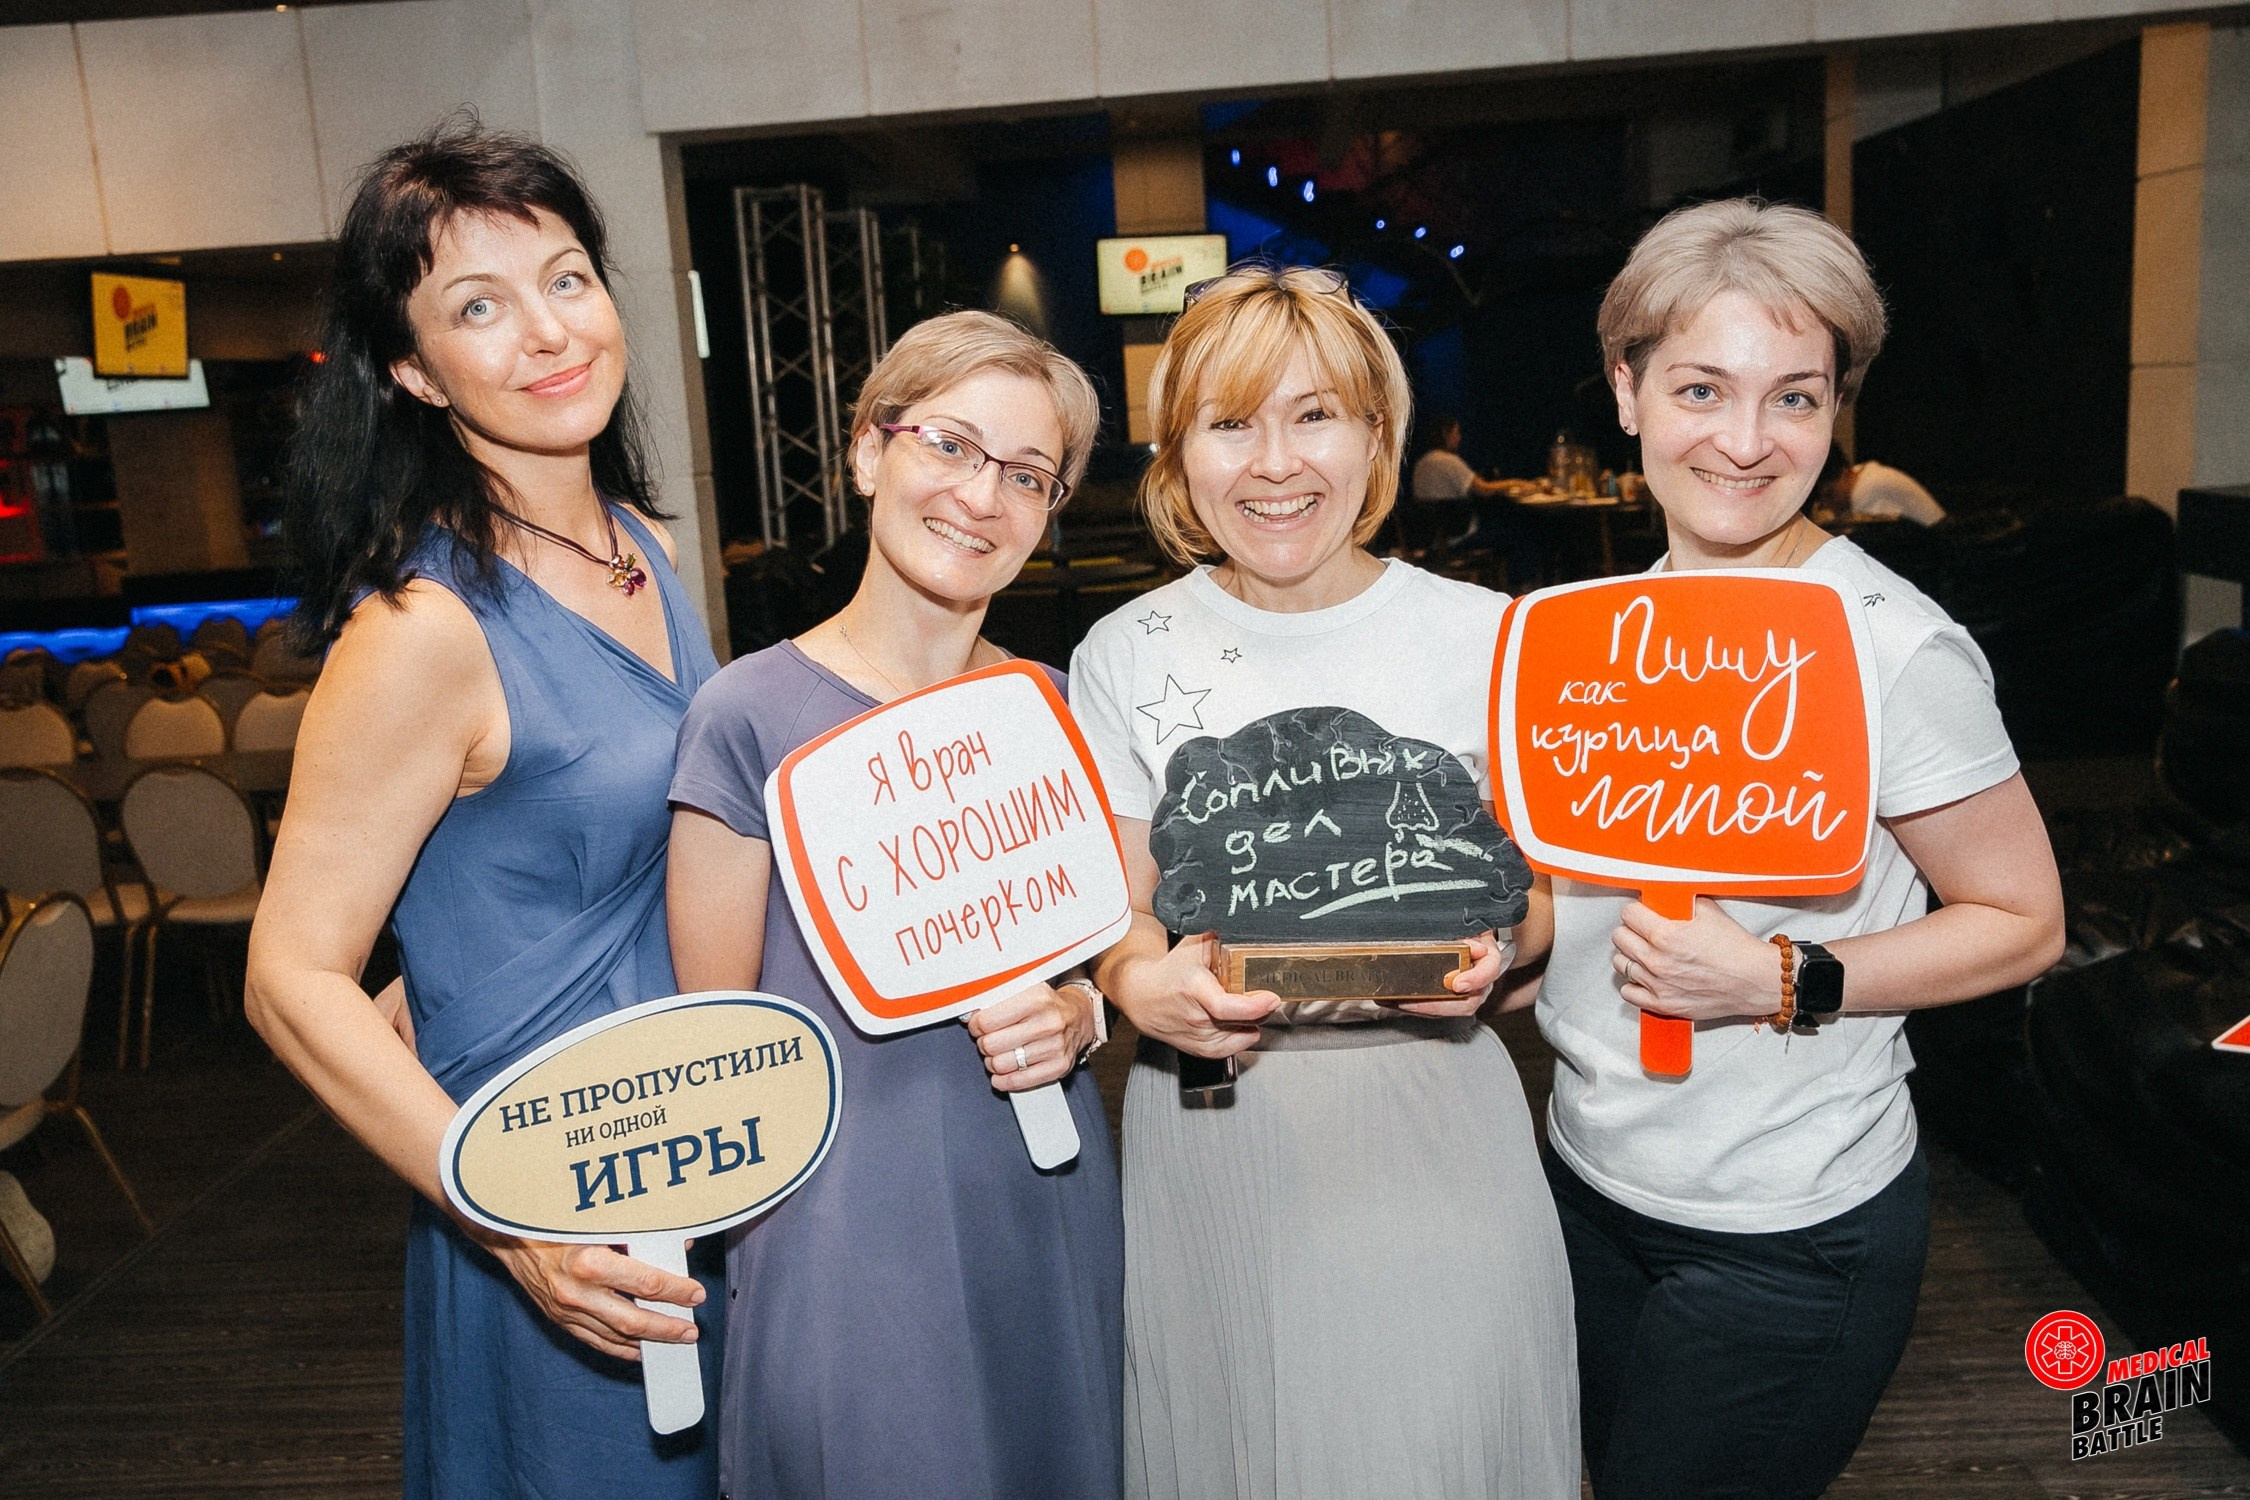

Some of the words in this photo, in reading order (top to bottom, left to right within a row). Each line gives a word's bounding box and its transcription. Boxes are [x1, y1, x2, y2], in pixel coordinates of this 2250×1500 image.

[1558, 680, 1628, 705] как
[1609, 595, 1817, 760] Пишу
[898, 730, 992, 804] врач
[1531, 721, 1721, 777] курица
[879, 769, 1086, 897] ХОРОШИМ
[1571, 771, 1847, 843] лапой
[895, 864, 1077, 966] почерком
[499, 1096, 552, 1133] НЕ
[560, 1036, 804, 1118] ПРОПУСТИЛИ
[569, 1116, 766, 1213] ИГРЫ
